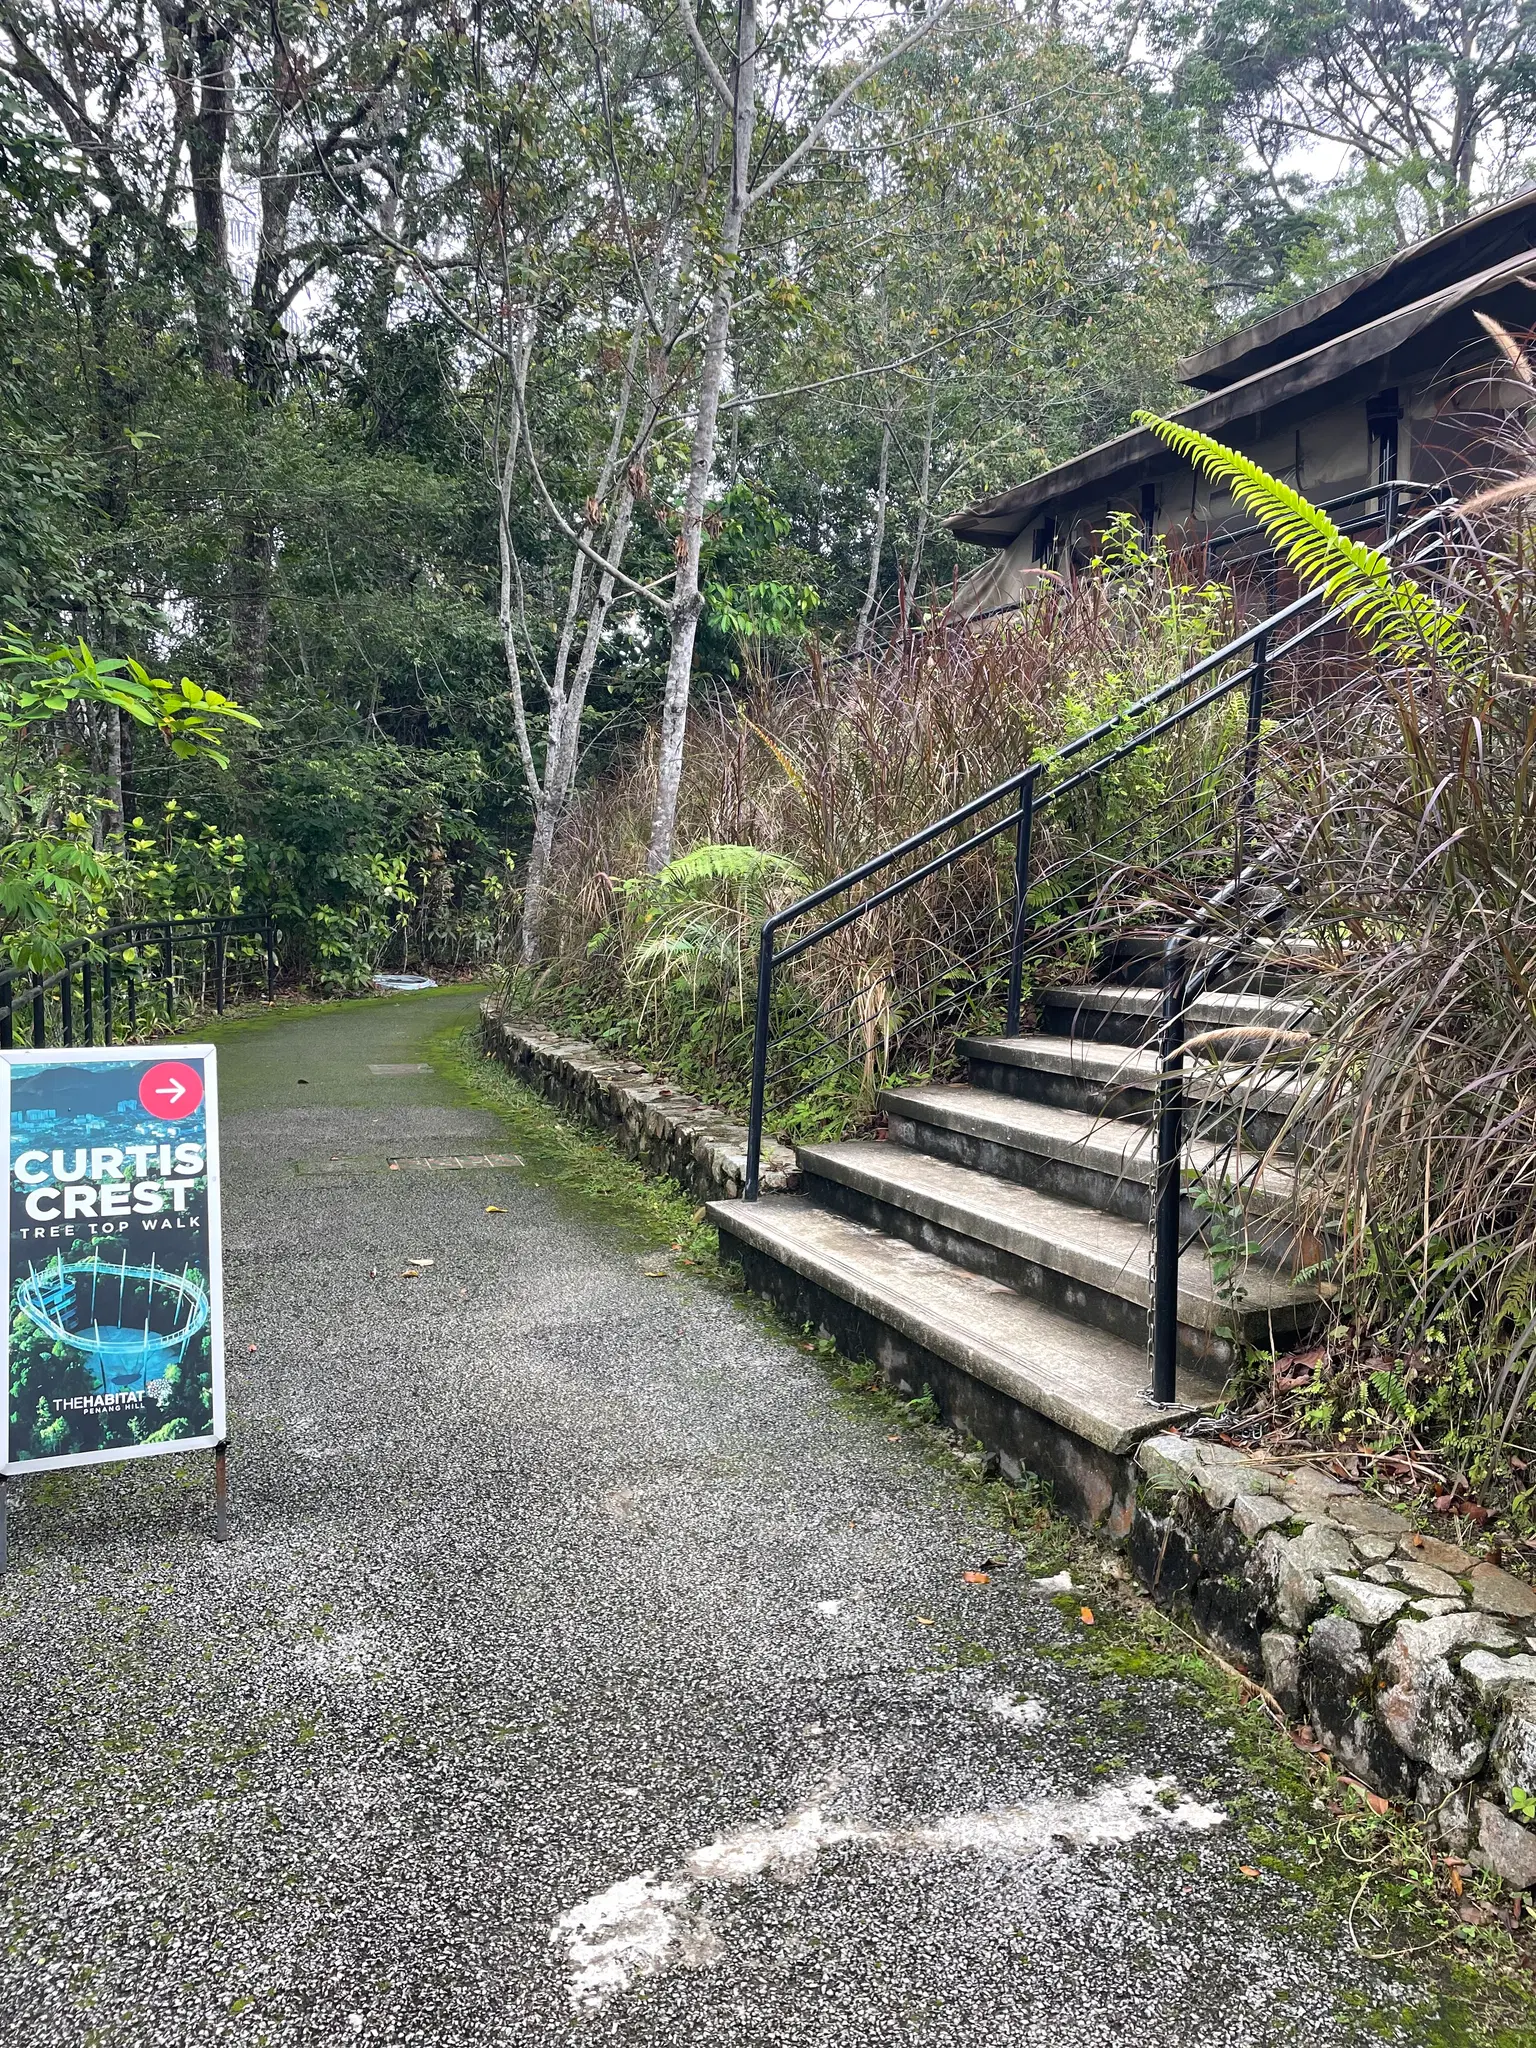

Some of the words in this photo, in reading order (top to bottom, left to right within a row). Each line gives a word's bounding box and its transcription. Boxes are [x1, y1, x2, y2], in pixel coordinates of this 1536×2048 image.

[14, 1143, 205, 1184] CURTIS
[25, 1179, 195, 1221] CREST
[20, 1225, 75, 1239] TREE
[88, 1222, 129, 1235] TOP
[142, 1216, 200, 1231] WALK
[83, 1404, 121, 1415] PENANG
[125, 1402, 146, 1410] HILL
